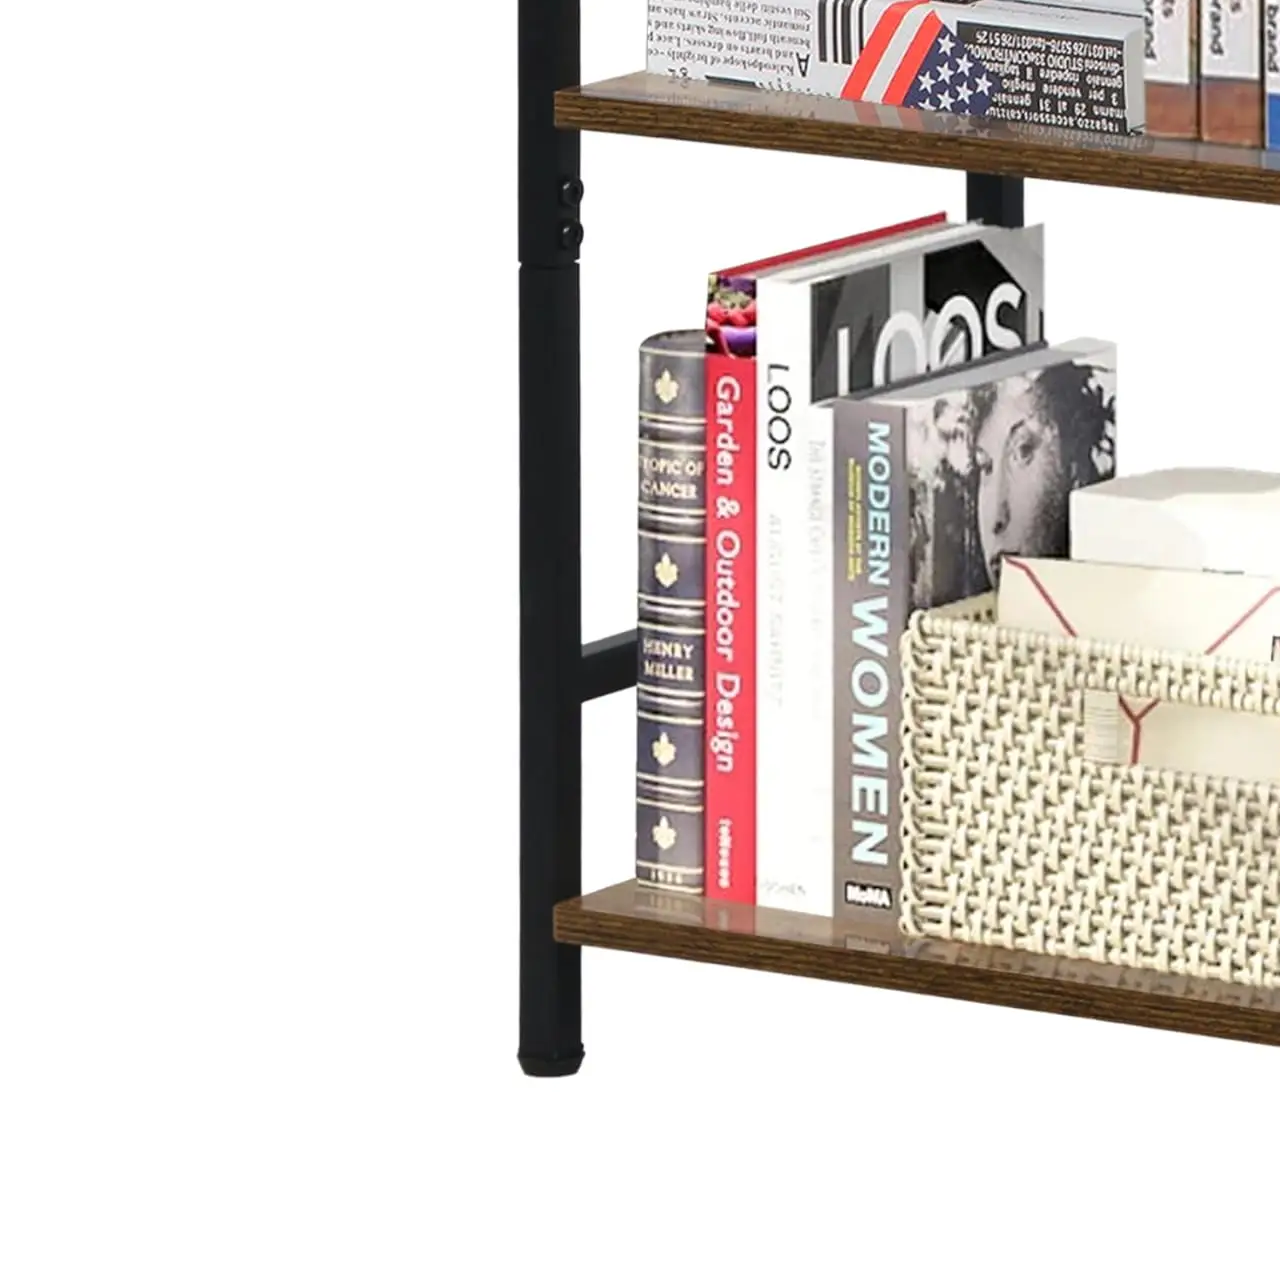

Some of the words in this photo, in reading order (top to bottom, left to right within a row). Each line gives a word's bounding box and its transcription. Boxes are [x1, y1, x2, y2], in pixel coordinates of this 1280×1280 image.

[655, 20, 674, 30] and
[1266, 5, 1280, 73] brand
[667, 49, 707, 65] brightly
[776, 50, 794, 60] and
[796, 52, 810, 79] A
[1046, 54, 1084, 72] STUDIO
[1001, 77, 1036, 93] meglio
[1042, 83, 1081, 99] vendere
[1088, 88, 1105, 102] per
[1039, 98, 1051, 112] 31
[1074, 102, 1086, 117] 29
[837, 282, 1023, 398] LOOS
[766, 363, 792, 471] LOOS
[715, 375, 741, 485] Garden
[641, 479, 697, 500] CANCER
[716, 495, 740, 519] &
[865, 421, 891, 587] MODERN
[715, 529, 741, 662] Outdoor
[643, 637, 695, 660] HENRY
[644, 659, 694, 682] MILLER
[710, 672, 741, 772] Design
[850, 595, 889, 867] WOMEN
